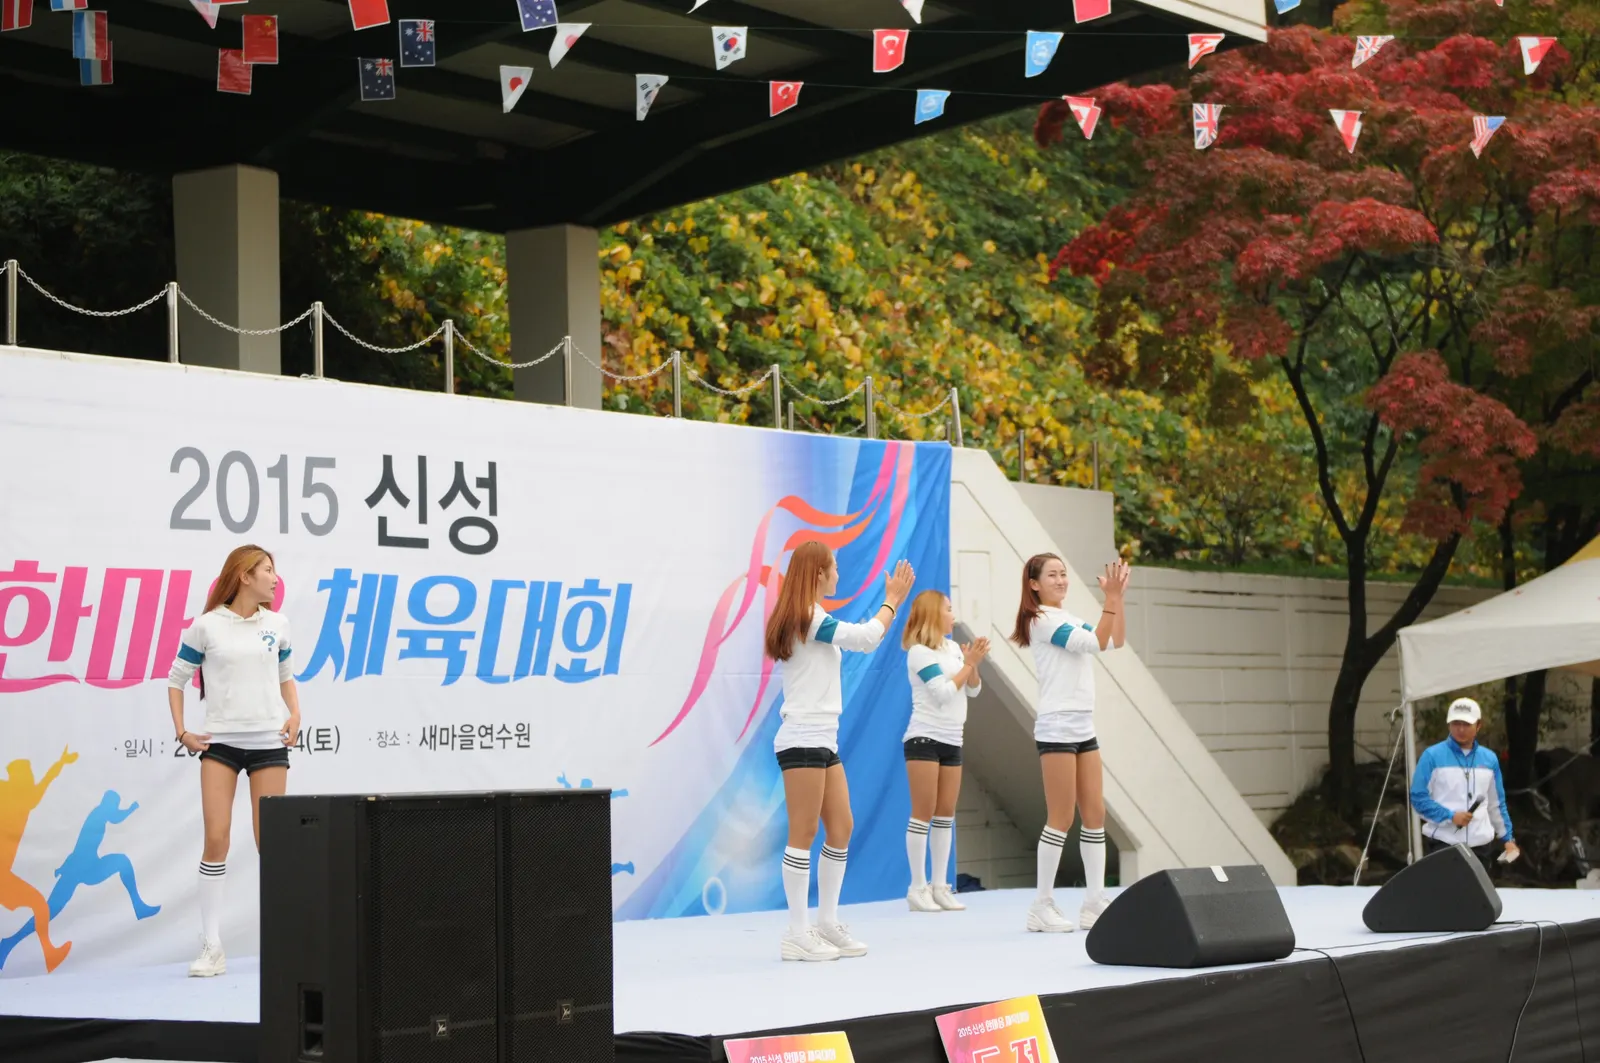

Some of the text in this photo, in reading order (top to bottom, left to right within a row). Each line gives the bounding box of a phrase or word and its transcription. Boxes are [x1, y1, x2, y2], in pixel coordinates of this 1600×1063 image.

[169, 446, 499, 555] 2015 신성
[0, 560, 633, 693] 한마 체육대회
[124, 738, 153, 757] 일시
[376, 730, 401, 748] 장소
[419, 722, 531, 751] 새마을연수원
[957, 1026, 973, 1038] 2015
[972, 1022, 986, 1035] 신성
